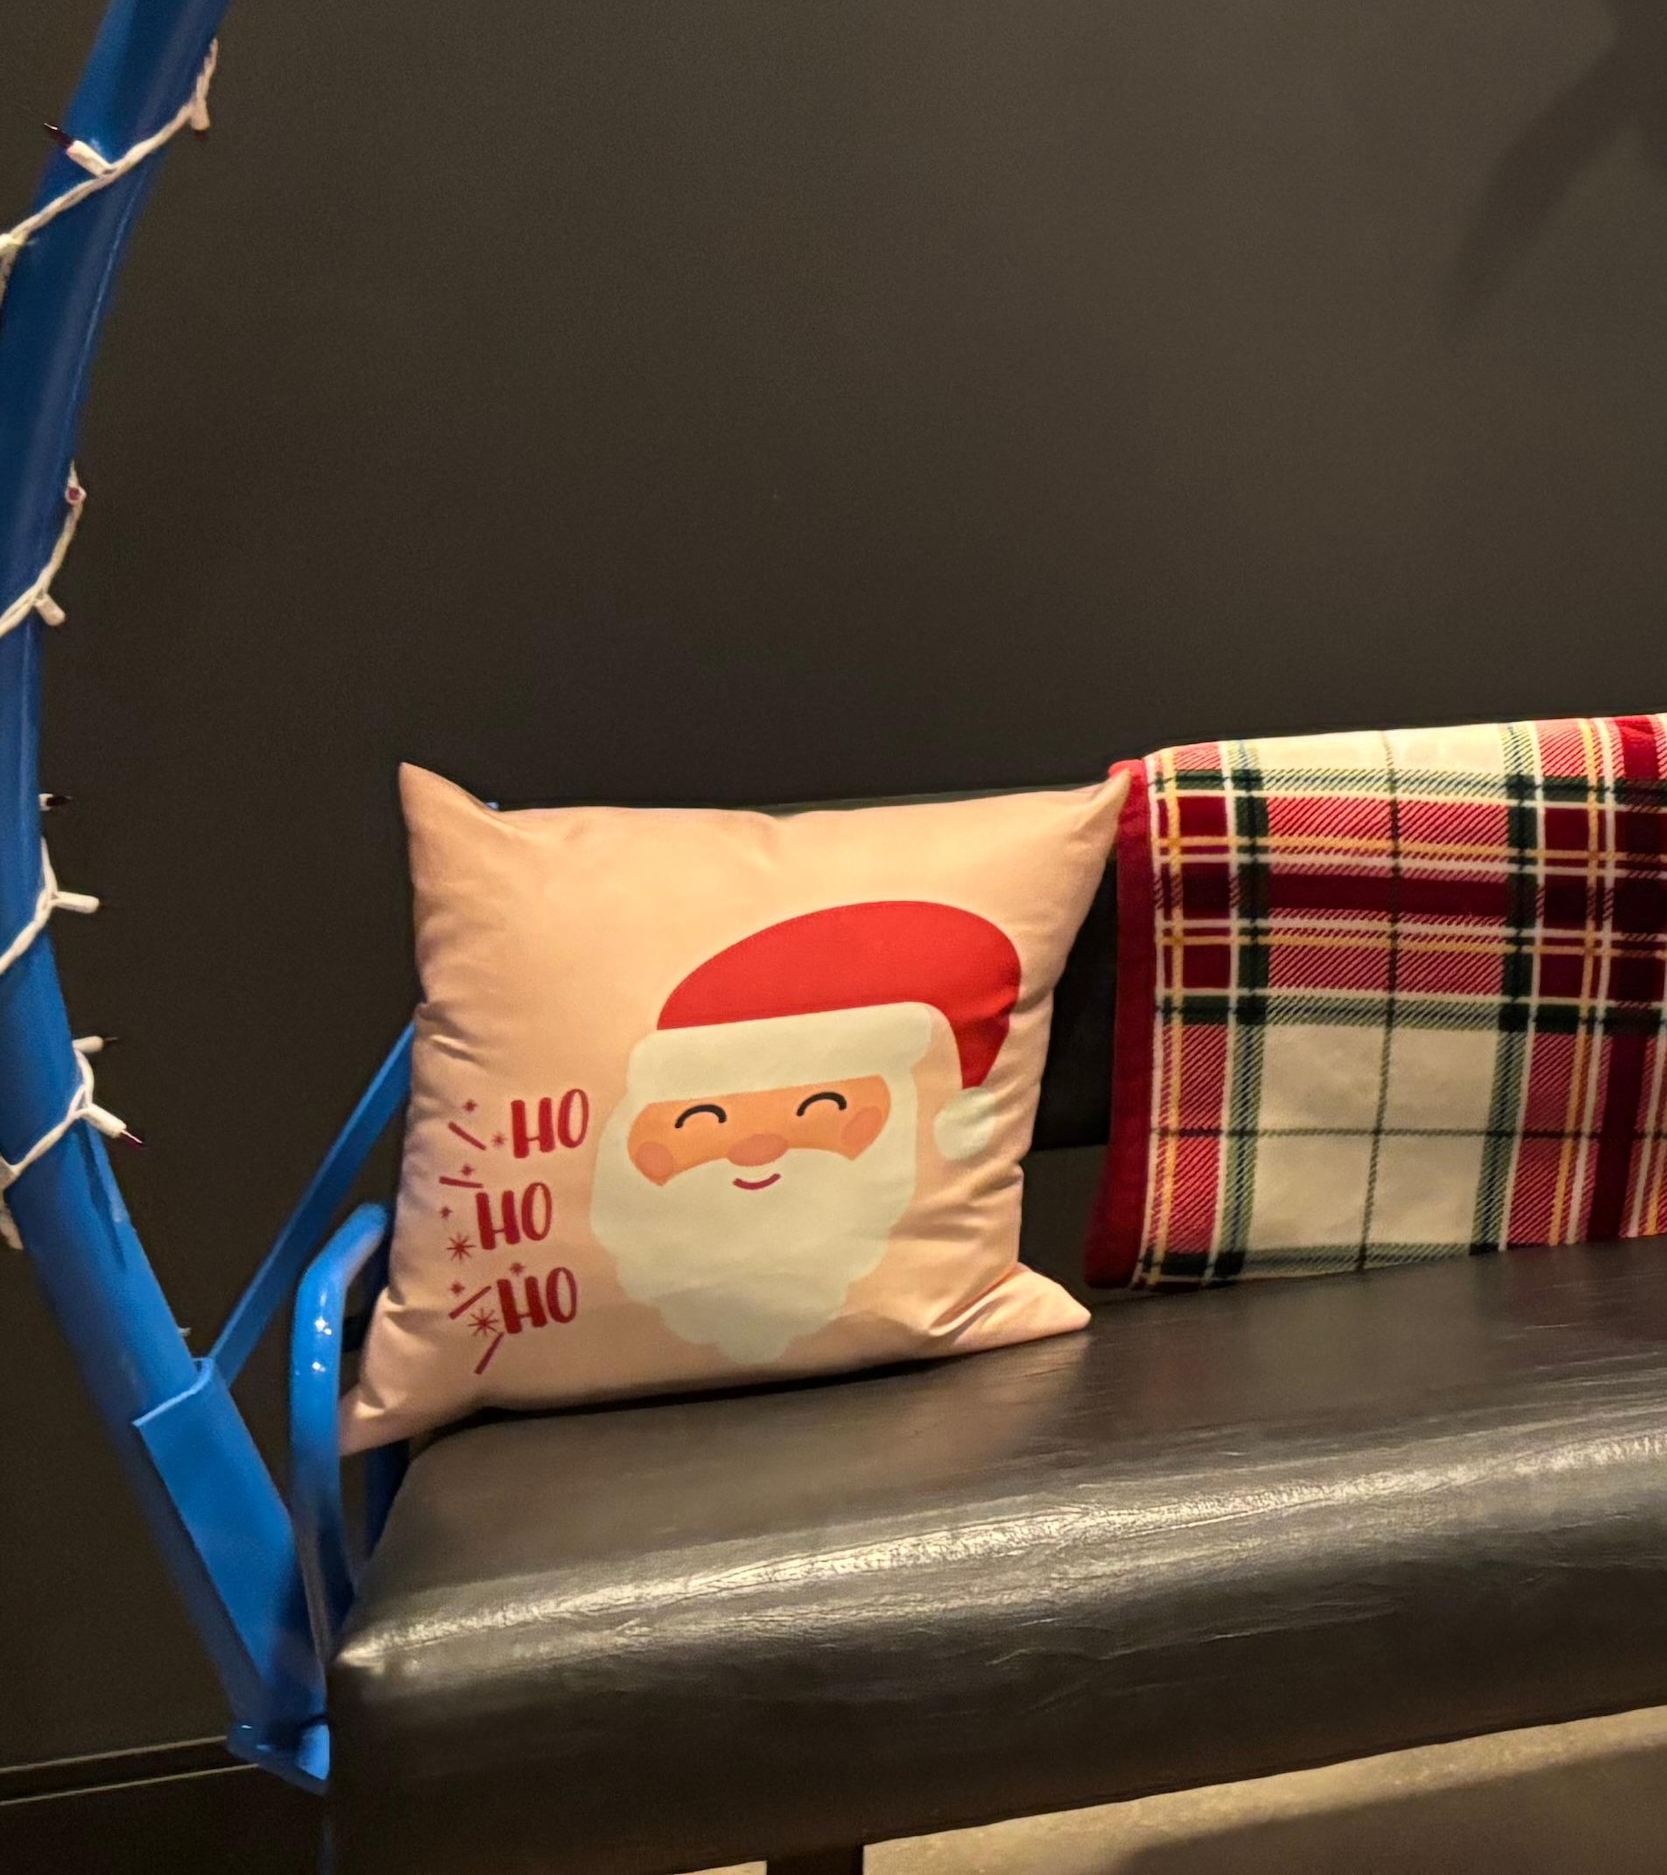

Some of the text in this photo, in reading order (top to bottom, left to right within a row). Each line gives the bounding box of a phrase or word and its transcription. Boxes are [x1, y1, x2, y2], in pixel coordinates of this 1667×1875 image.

[511, 1088, 590, 1159] HO
[475, 1181, 553, 1251] HO
[497, 1266, 578, 1334] HO
